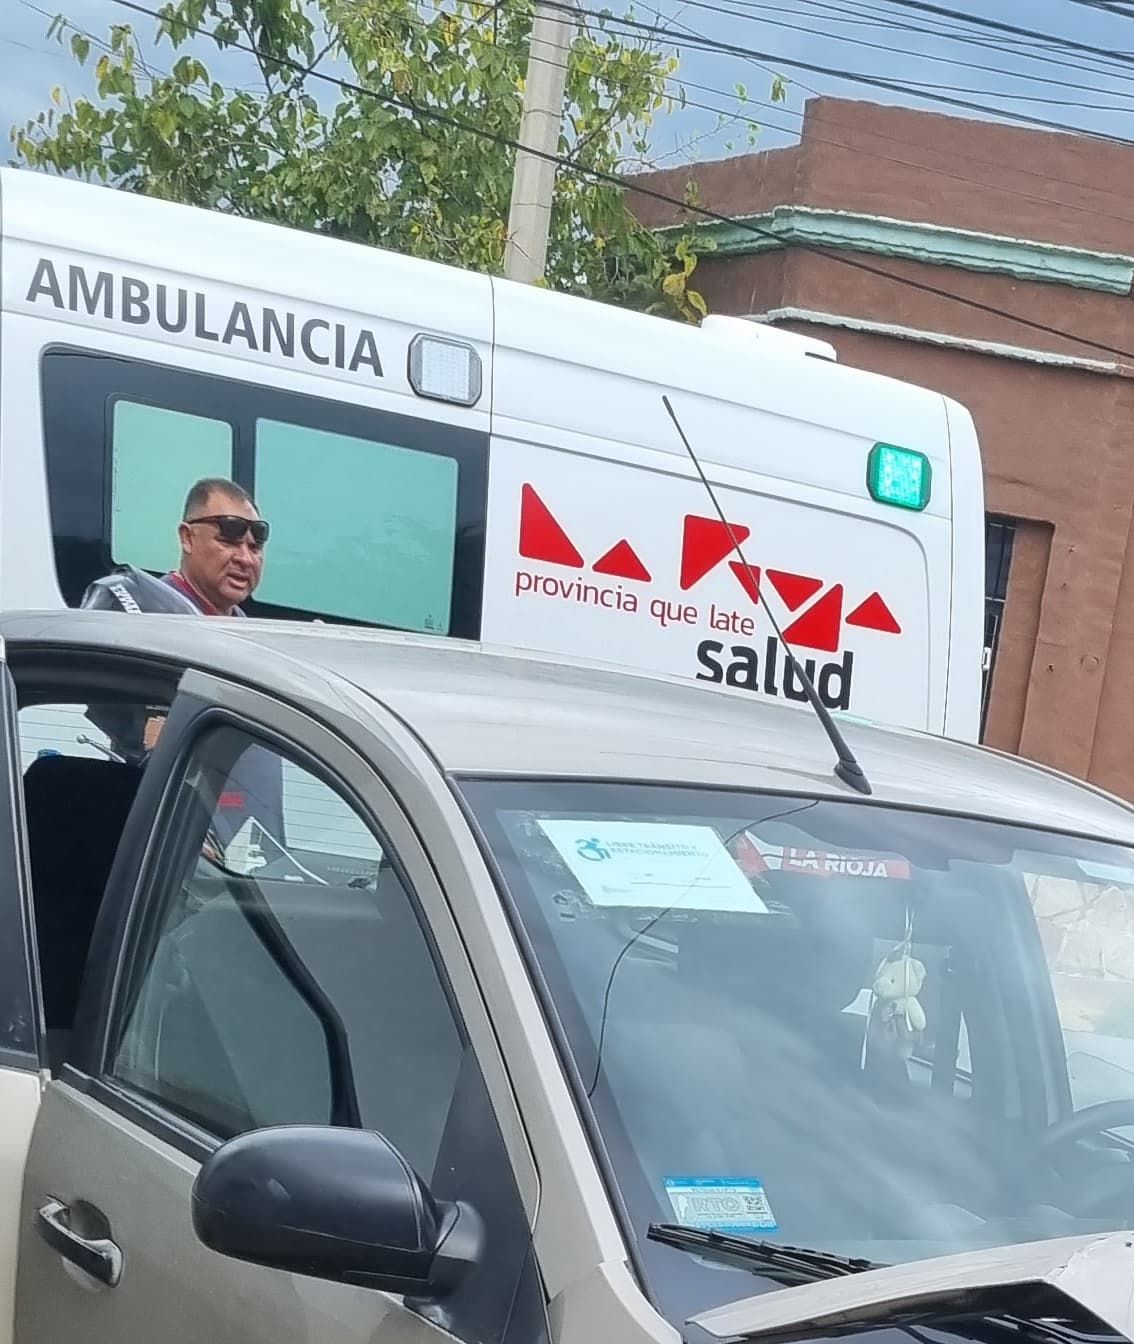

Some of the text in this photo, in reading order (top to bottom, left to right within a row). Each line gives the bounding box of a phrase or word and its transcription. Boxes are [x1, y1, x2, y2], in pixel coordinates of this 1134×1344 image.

[26, 258, 384, 377] AMBULANCIA
[515, 570, 755, 636] provincia que late
[695, 636, 854, 711] salud
[789, 847, 889, 878] LA RIOJA
